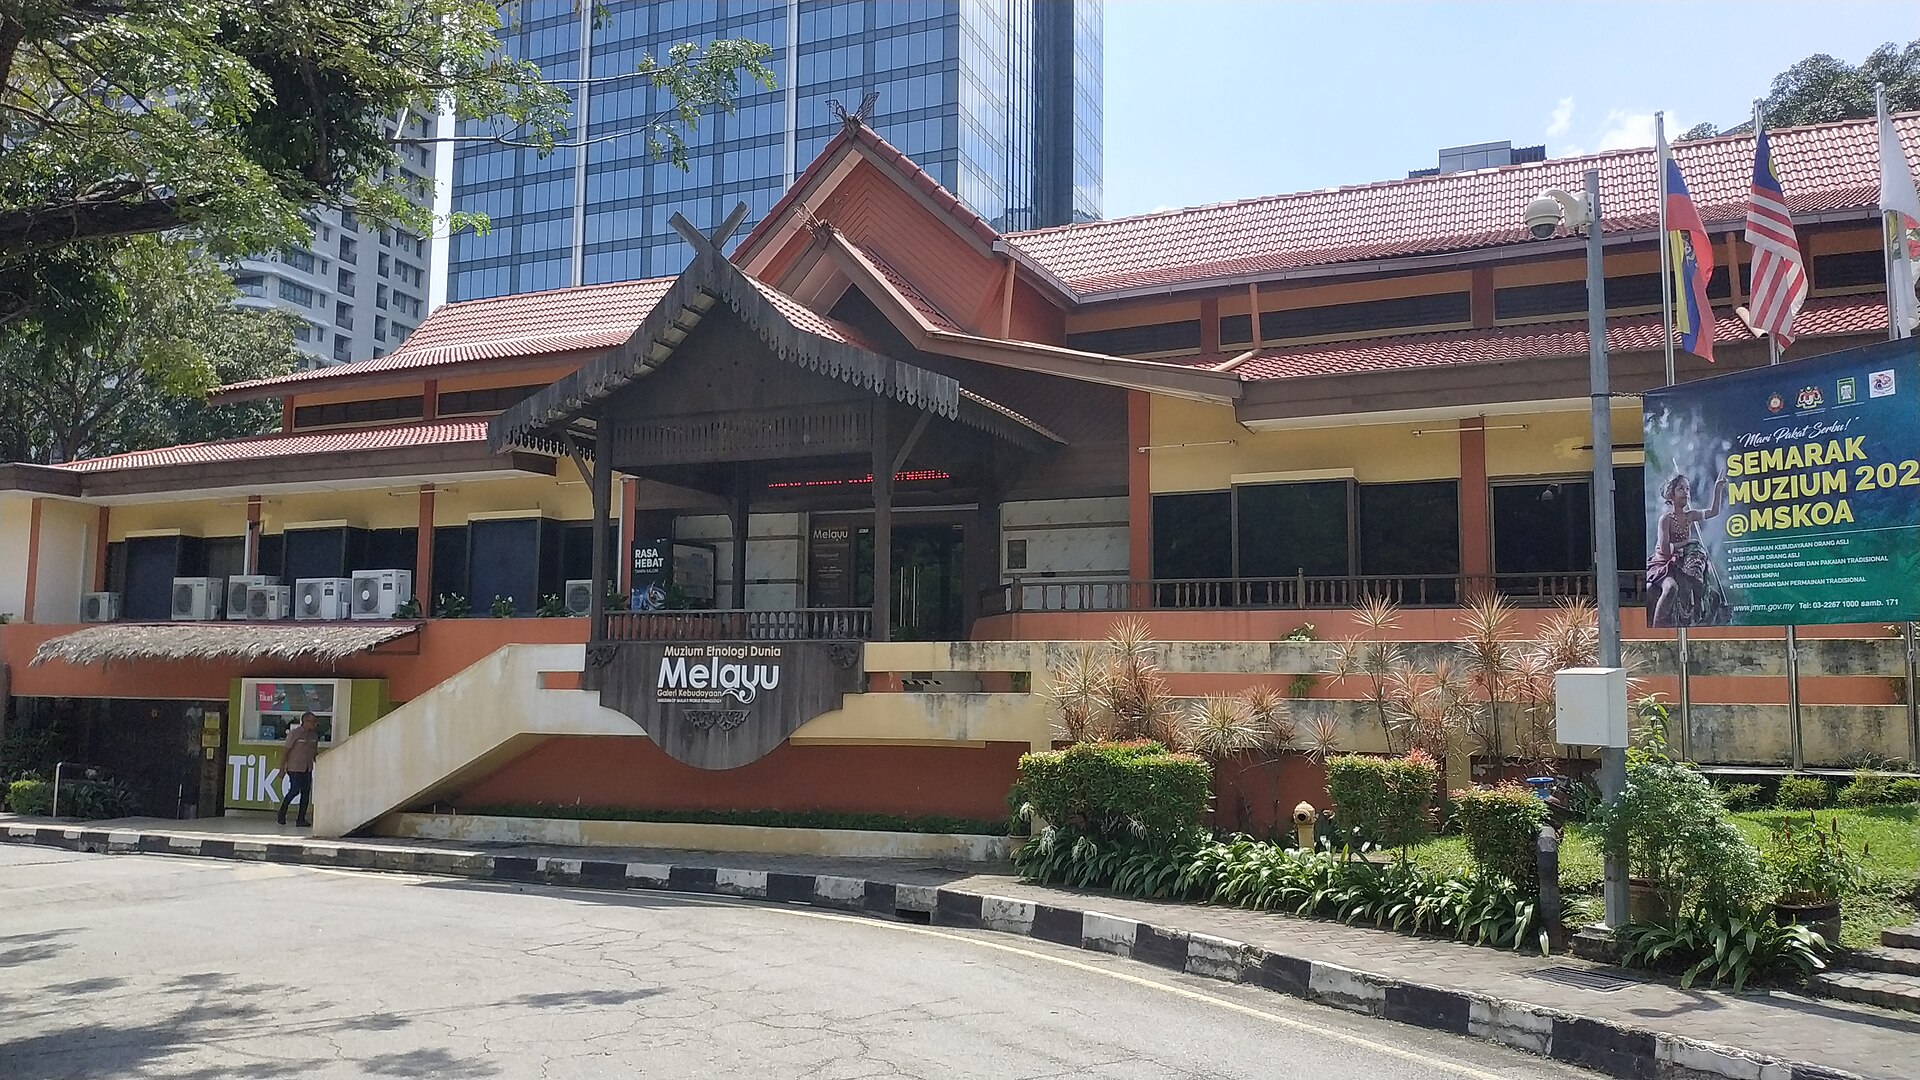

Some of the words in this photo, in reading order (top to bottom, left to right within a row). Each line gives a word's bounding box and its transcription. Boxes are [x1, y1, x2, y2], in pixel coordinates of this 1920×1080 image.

[1773, 425, 1811, 443] Pakat
[1726, 435, 1868, 477] SEMARAK
[1728, 469, 1847, 505] MUZIUM
[1726, 499, 1855, 537] @MSKOA
[813, 529, 848, 541] Melayu
[635, 548, 658, 558] RASA
[1732, 545, 1774, 553] PERSEMBAHAN
[1774, 542, 1813, 550] KEBUDAYAAN
[635, 558, 664, 568] HEBAT
[1847, 555, 1889, 563] TRADISIONAL
[1733, 581, 1776, 589] PERTANDINGAN
[1790, 578, 1825, 586] PERMAINAN
[1826, 576, 1867, 584] TRADISIONAL
[1733, 602, 1795, 613] www.jmm.gov.my
[1813, 601, 1840, 609] 03-2267
[1842, 600, 1859, 608] 1000
[1860, 599, 1884, 607] samb.
[664, 645, 704, 657] Muzium
[706, 645, 748, 659] Etnologi
[750, 646, 781, 657] Dunia
[657, 656, 780, 704] Melayu
[657, 689, 677, 697] Galeri
[678, 689, 722, 698] Kebudayaan
[228, 754, 315, 805] Tik
